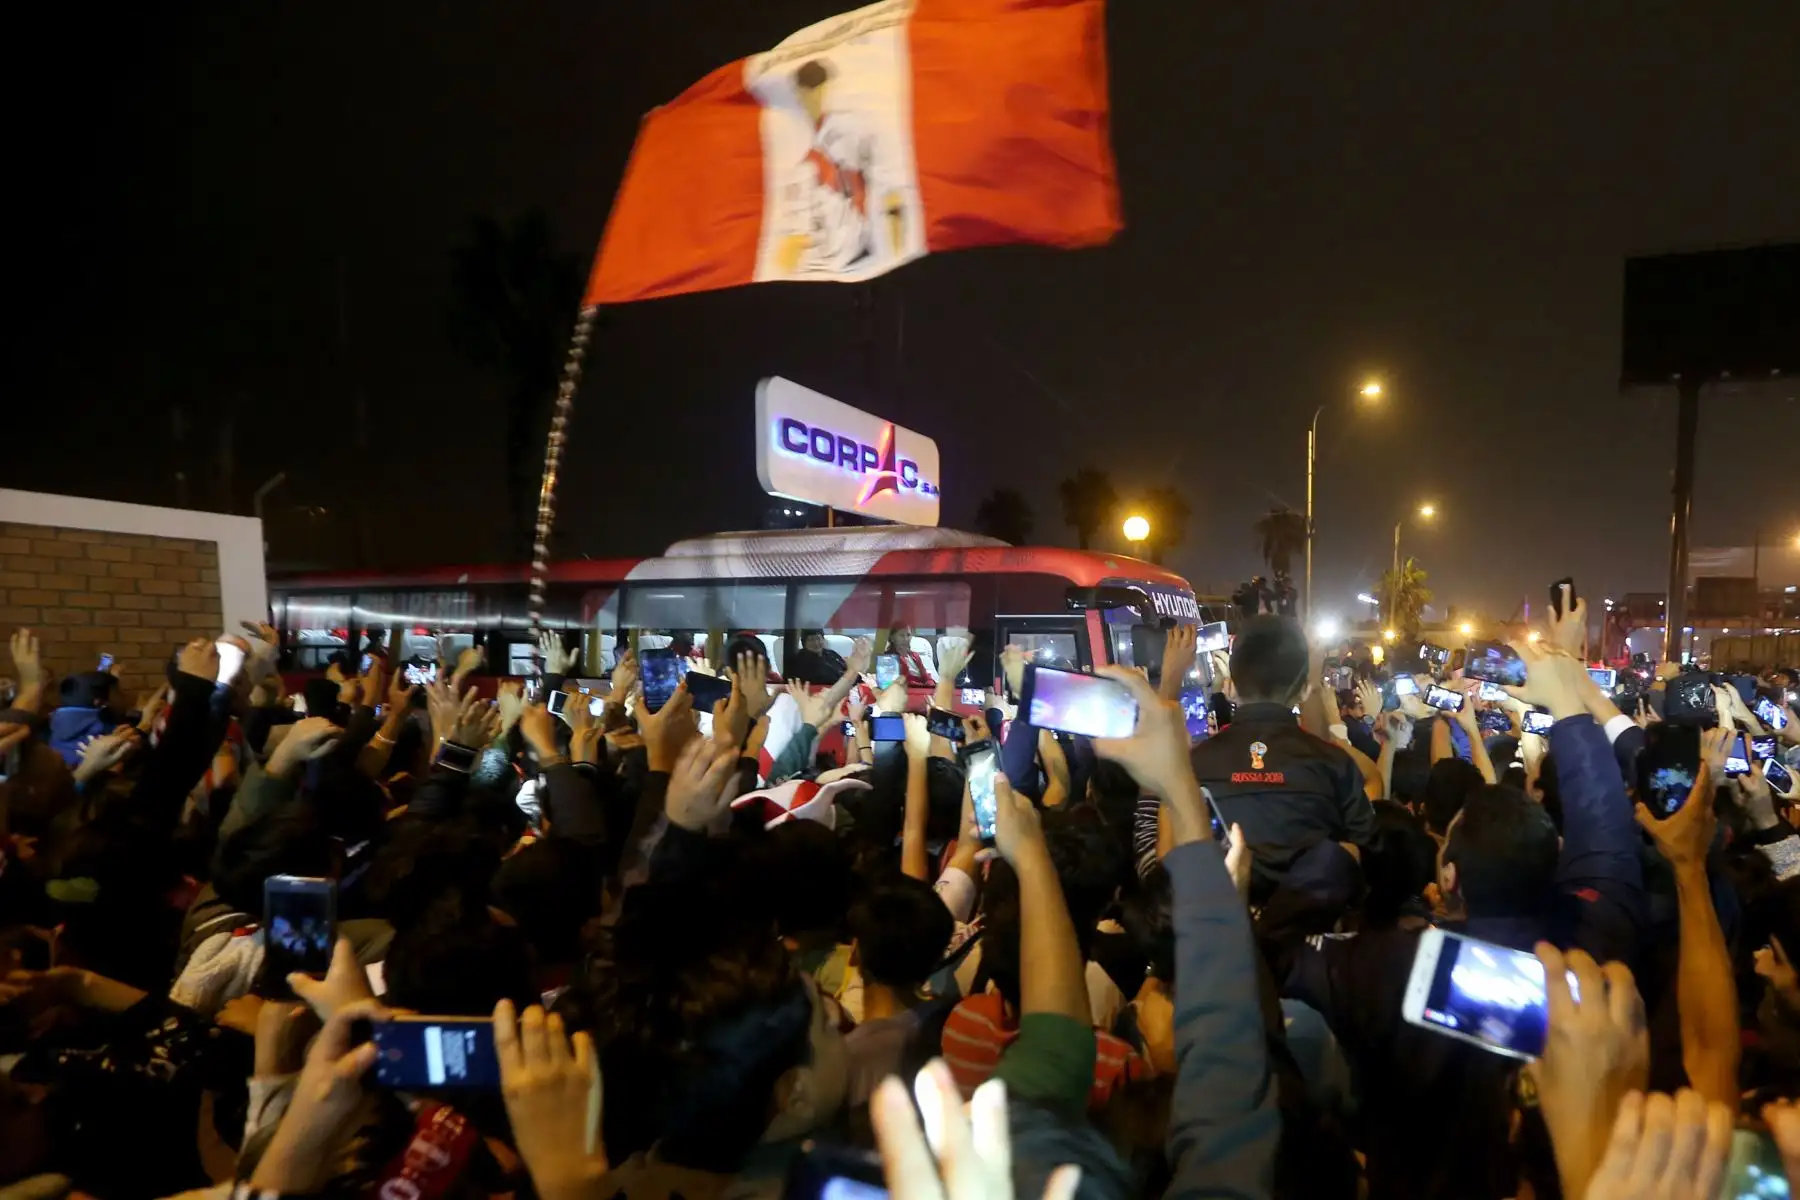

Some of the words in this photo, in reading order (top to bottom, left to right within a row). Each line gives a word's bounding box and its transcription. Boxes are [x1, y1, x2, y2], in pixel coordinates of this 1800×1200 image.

[781, 417, 919, 505] CORPAC
[1151, 591, 1201, 618] HYUNDA
[1231, 772, 1262, 783] RUSSIA
[1263, 772, 1285, 784] 2018
